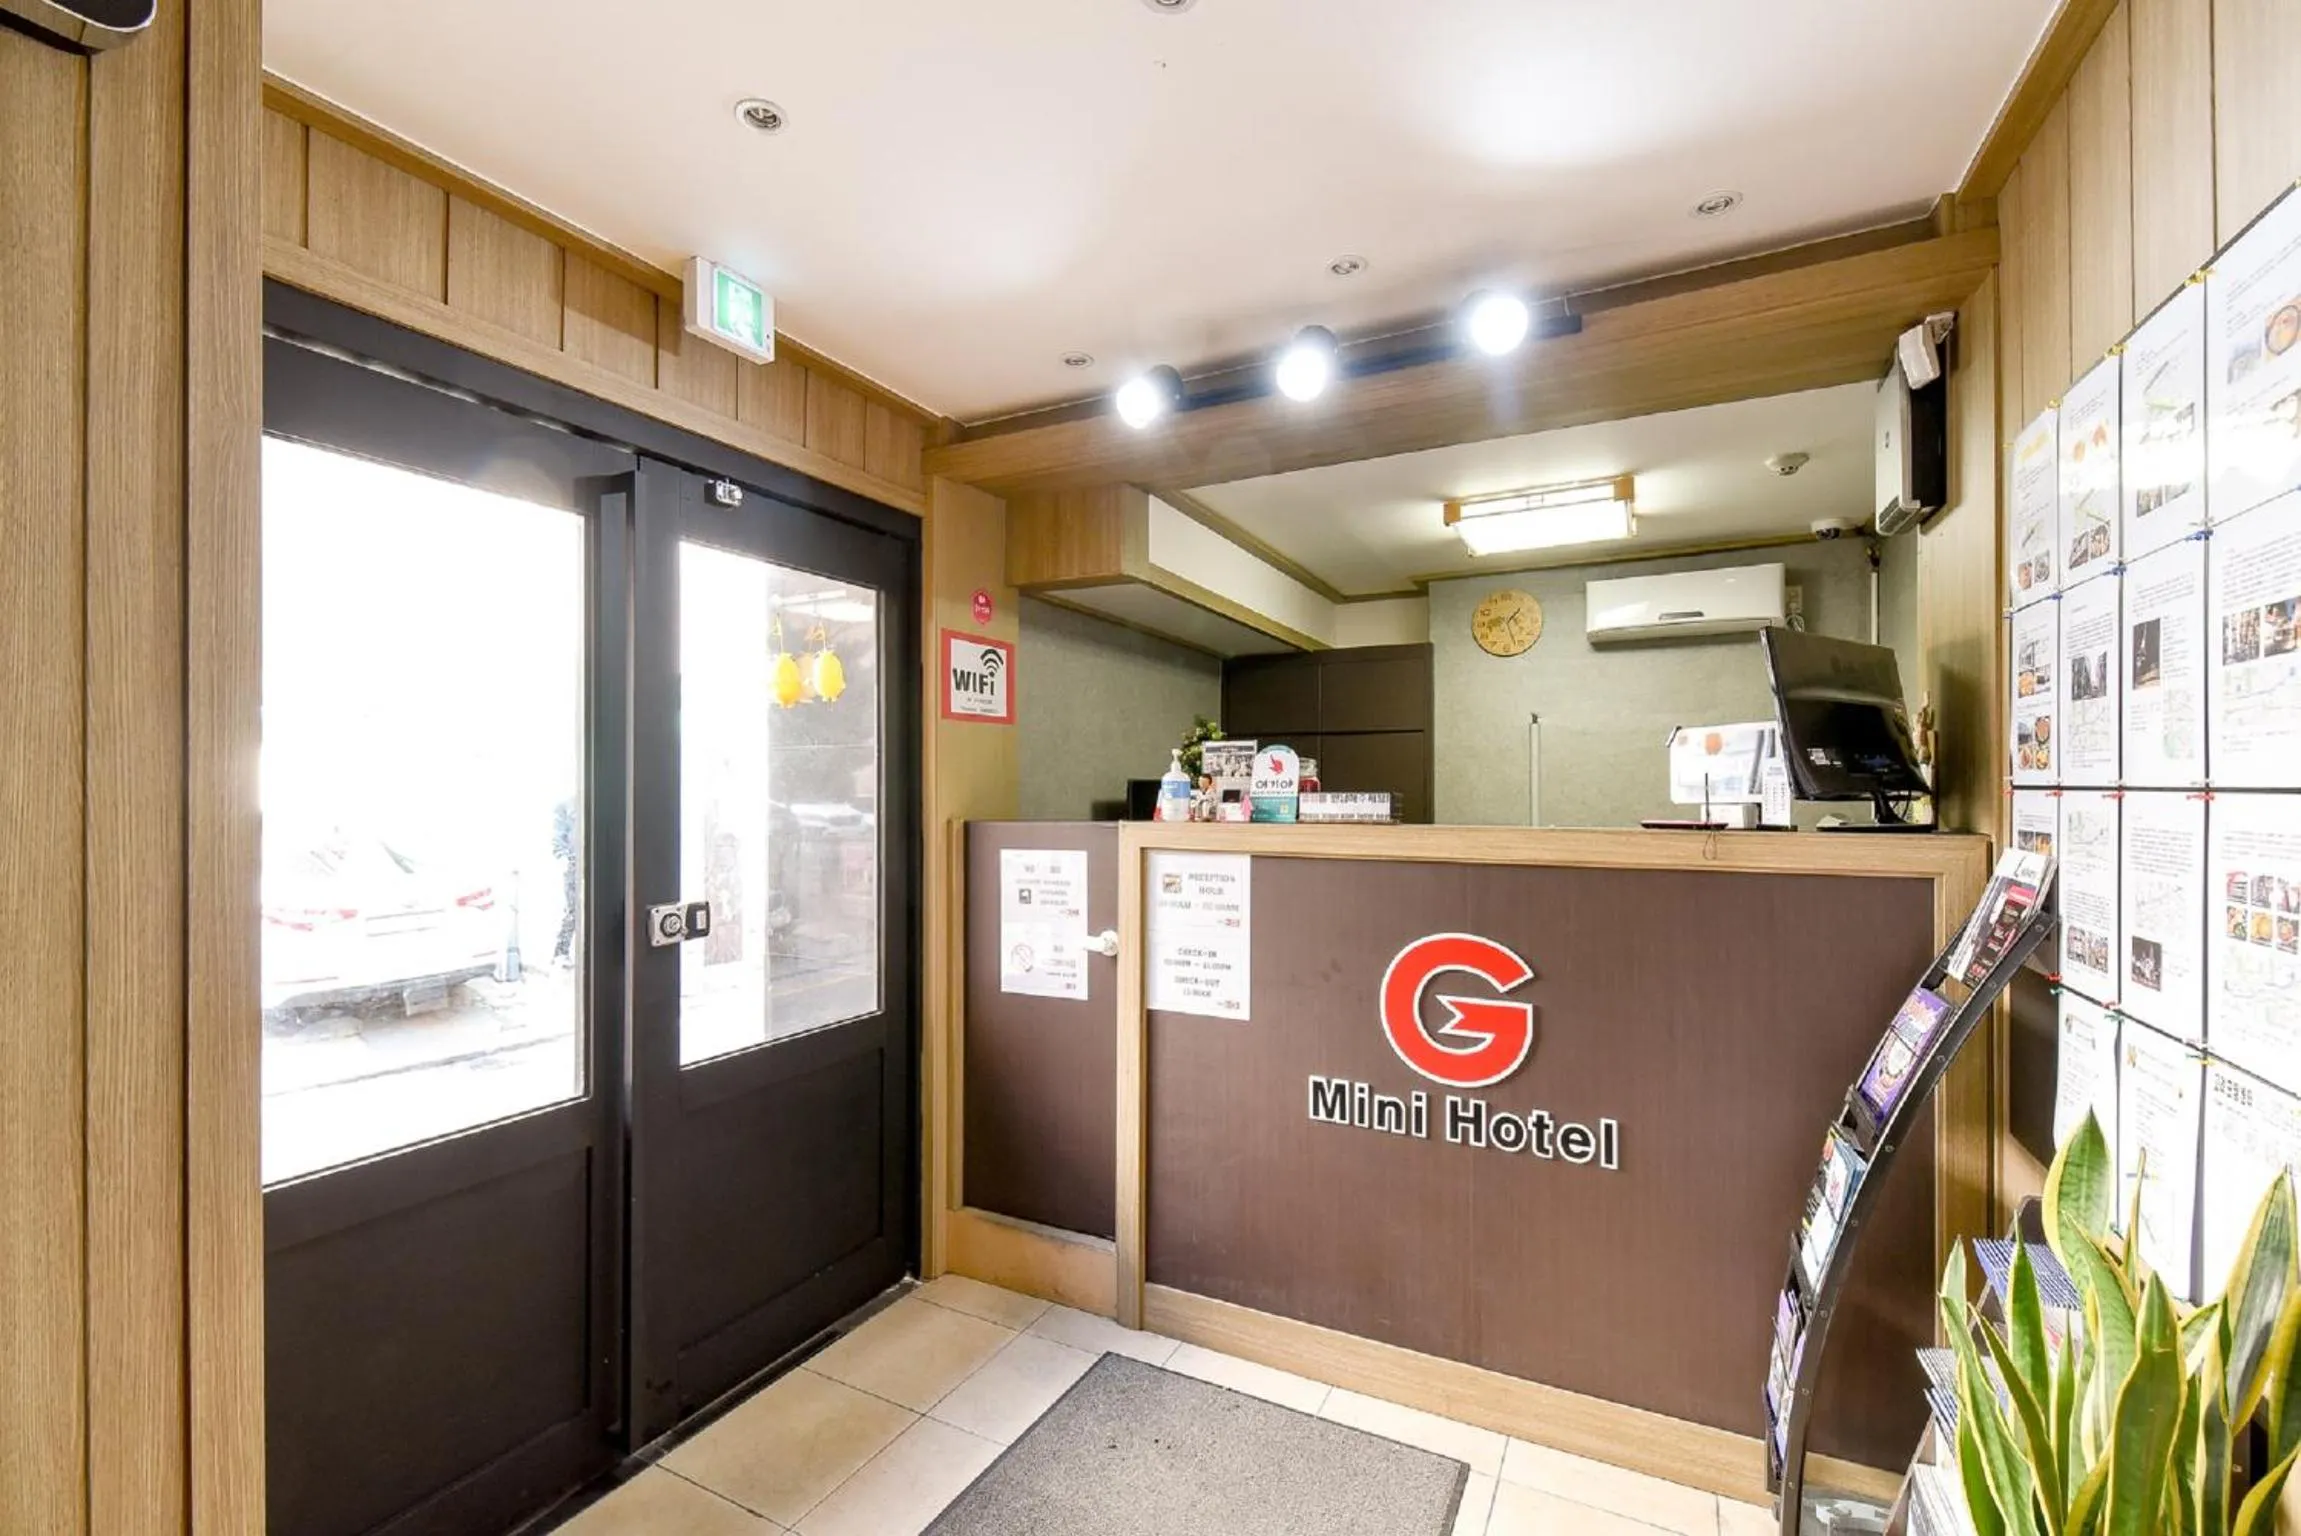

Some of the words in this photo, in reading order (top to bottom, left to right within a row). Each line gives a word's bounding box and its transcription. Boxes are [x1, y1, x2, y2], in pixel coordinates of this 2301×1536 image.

[1380, 932, 1535, 1088] G
[1308, 1075, 1428, 1139] Mini
[1446, 1095, 1619, 1170] Hotel
